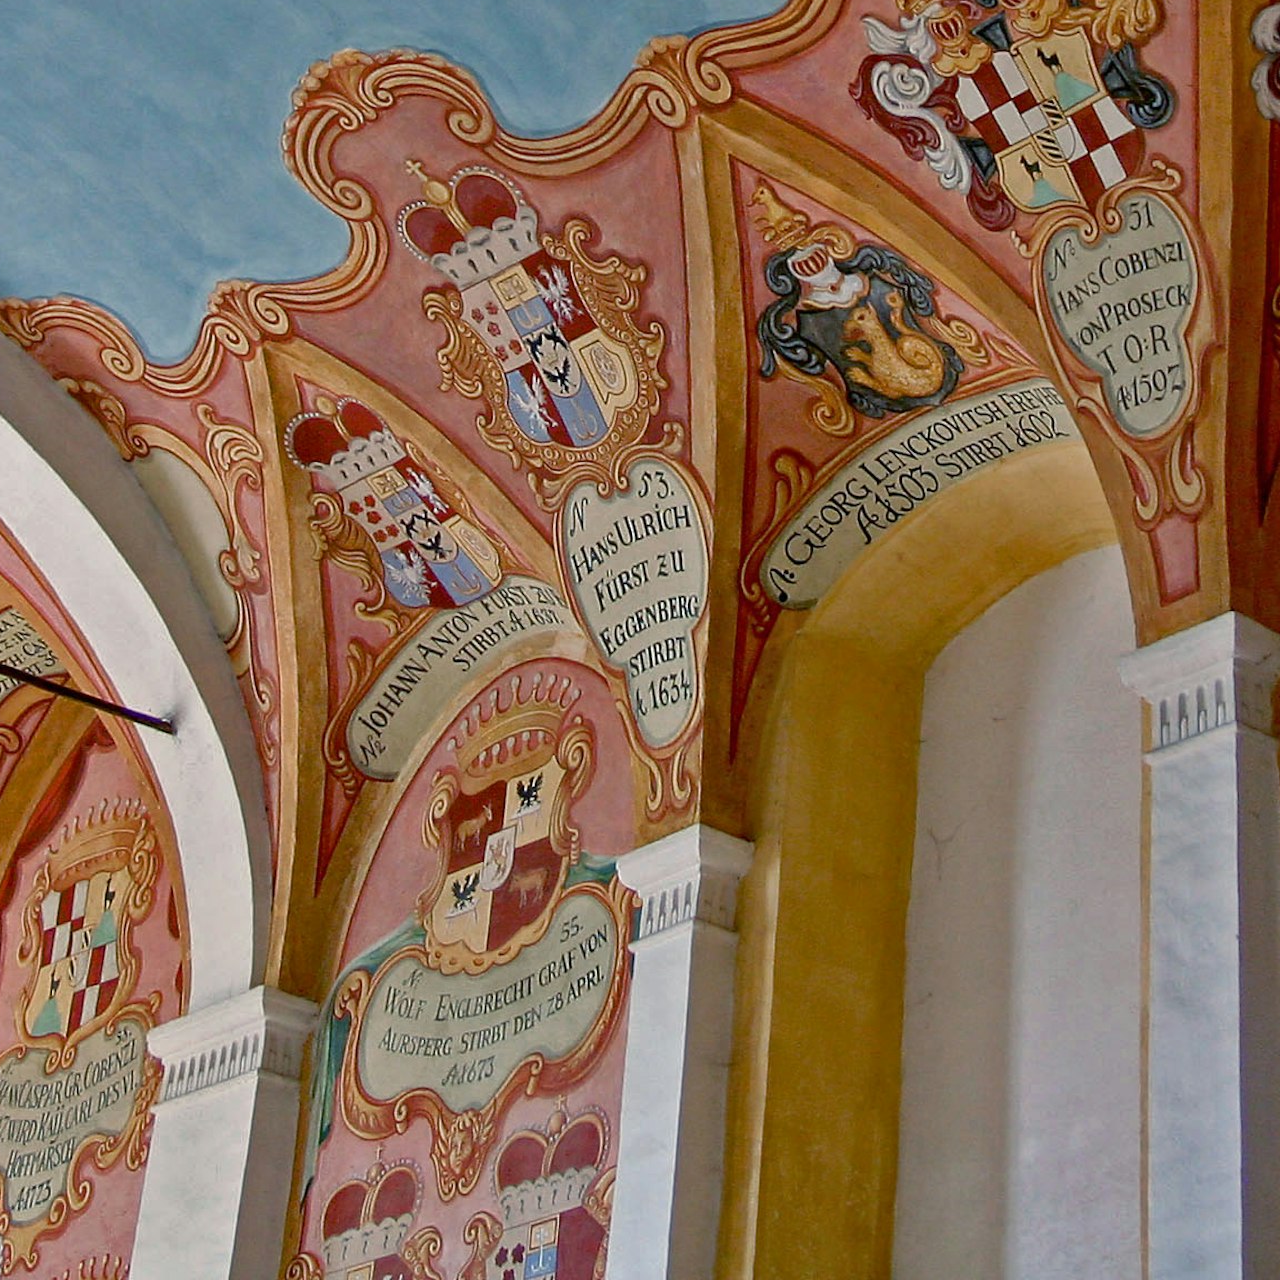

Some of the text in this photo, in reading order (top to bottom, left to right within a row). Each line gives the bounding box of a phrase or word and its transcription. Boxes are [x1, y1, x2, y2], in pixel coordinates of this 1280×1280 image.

[1128, 201, 1155, 231] 51
[934, 430, 1016, 480] STIRBT
[784, 477, 875, 566] GEORG
[571, 532, 618, 583] HANS
[416, 607, 481, 668] ANTON
[452, 620, 512, 672] STIRBT
[599, 594, 700, 657] EGGENBERG
[629, 635, 687, 679] STIRBT
[537, 946, 577, 988] GRAF
[578, 923, 609, 960] VON
[378, 1026, 453, 1058] AURSPERG
[459, 1019, 510, 1055] STIRBT
[512, 1004, 543, 1037] DEN
